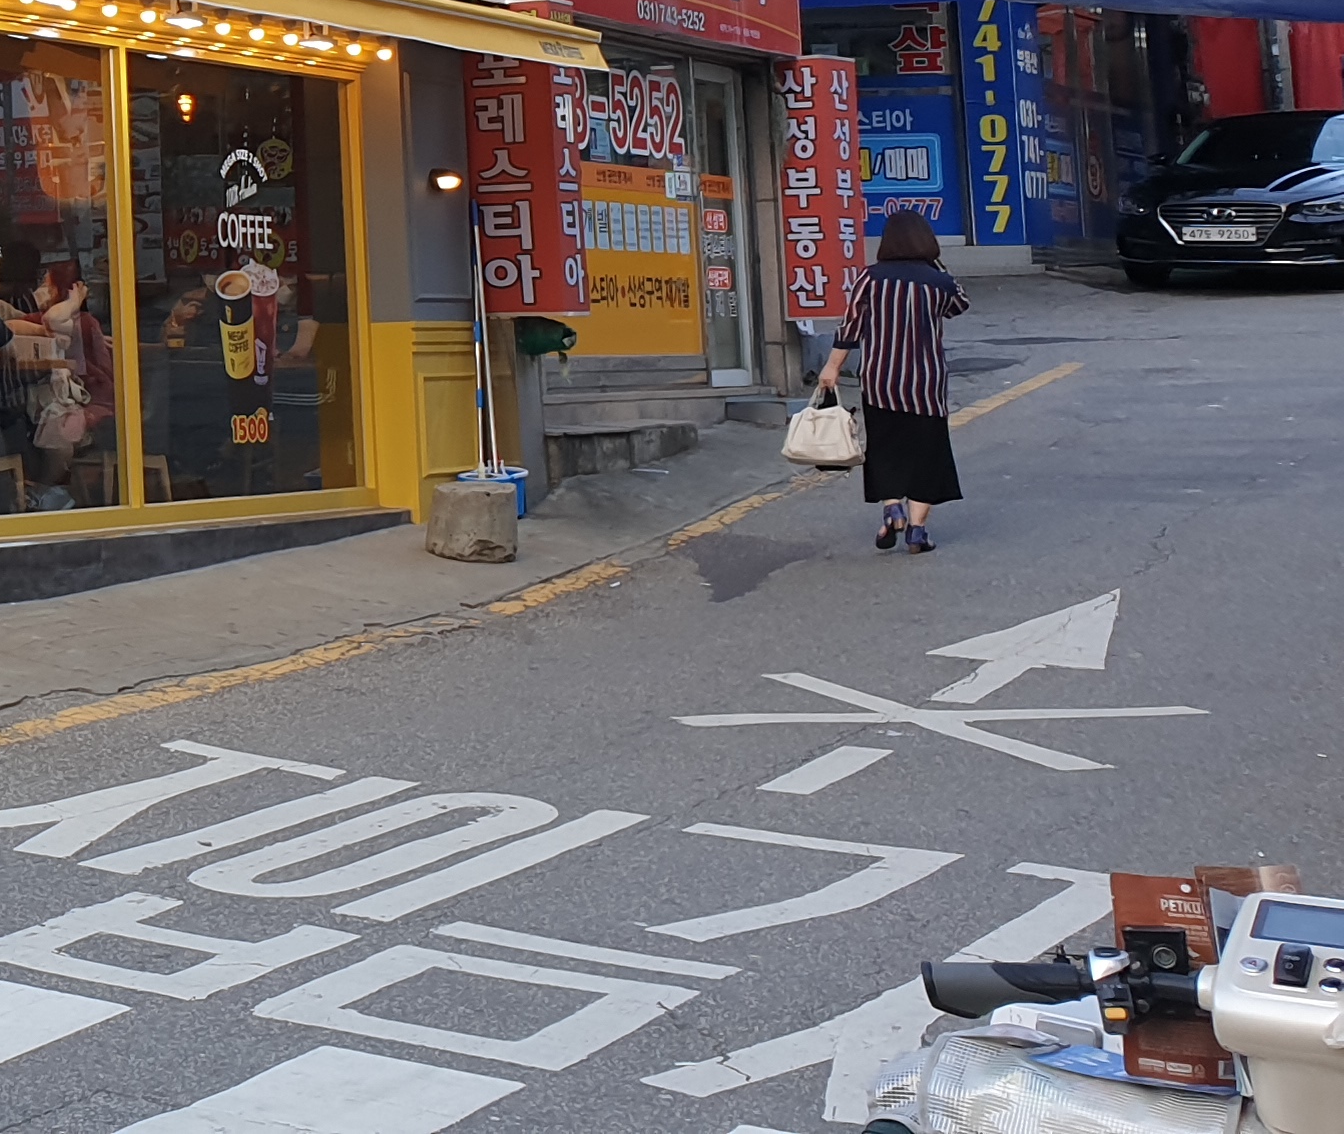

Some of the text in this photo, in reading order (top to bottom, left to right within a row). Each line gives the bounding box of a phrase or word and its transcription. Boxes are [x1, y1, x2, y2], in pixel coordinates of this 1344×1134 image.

[780, 67, 830, 308] 산성부동산
[217, 211, 274, 251] COFFEE
[1217, 228, 1250, 240] 9250
[230, 415, 268, 444] 1500
